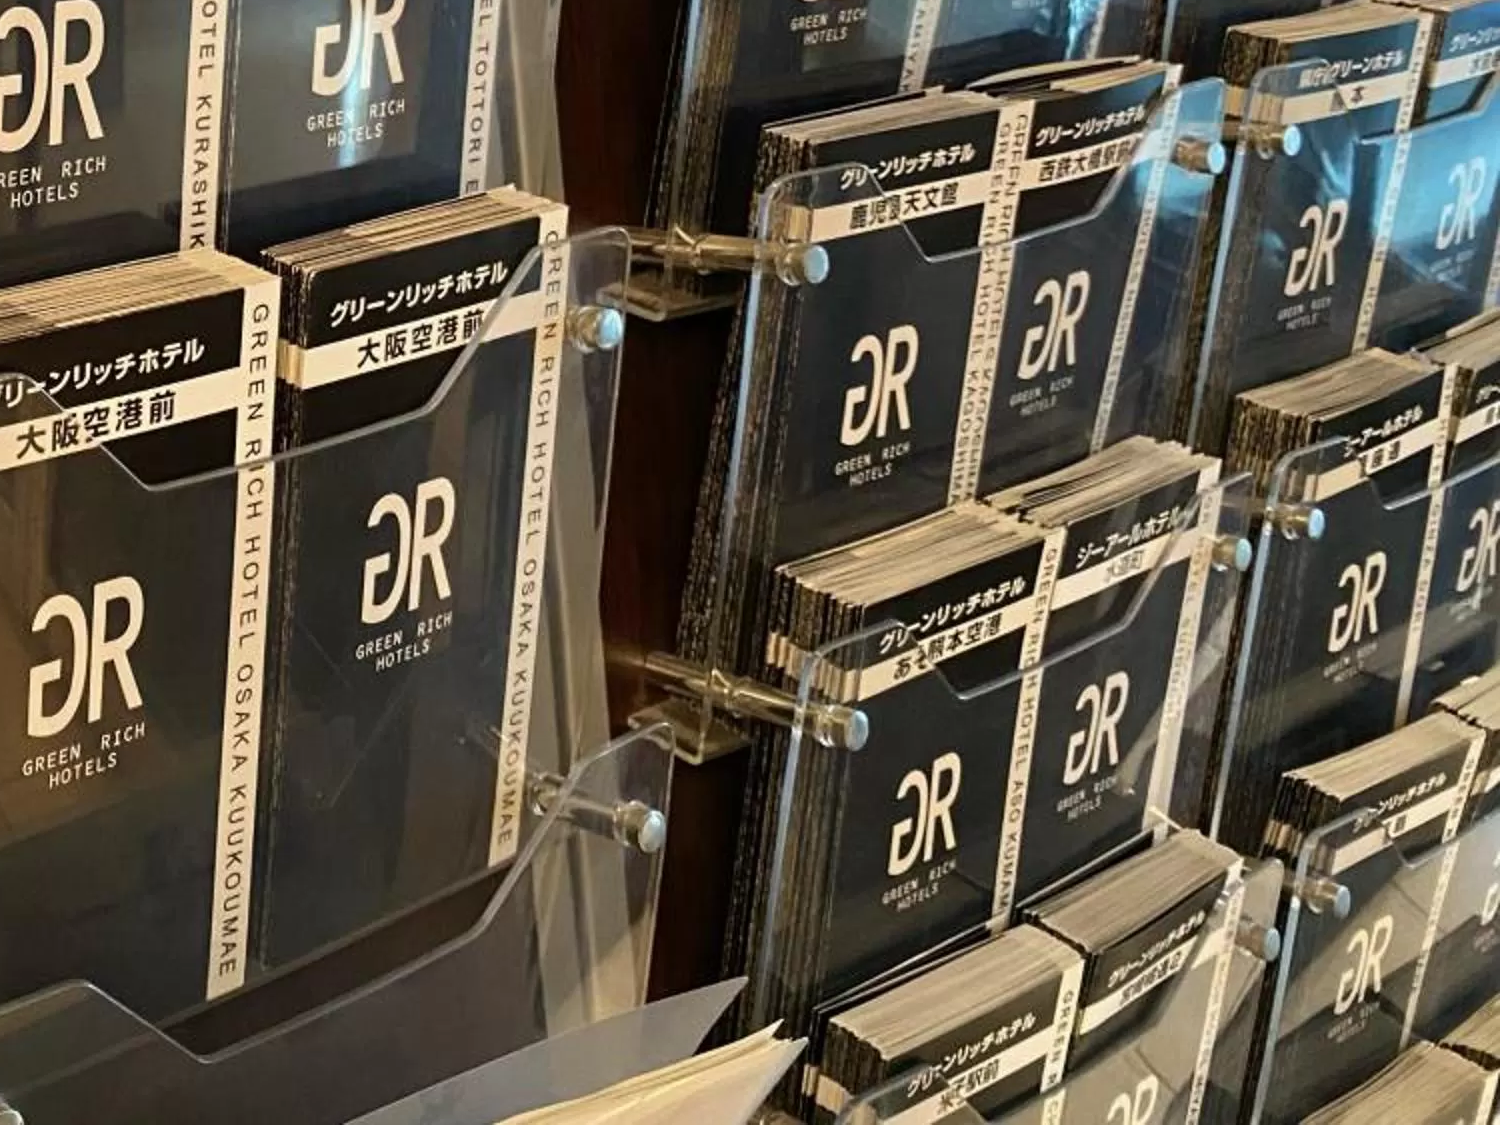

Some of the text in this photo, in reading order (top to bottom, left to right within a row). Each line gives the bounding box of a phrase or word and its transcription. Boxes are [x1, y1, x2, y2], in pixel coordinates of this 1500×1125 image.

[307, 97, 405, 132] GREEN RICH
[468, 39, 490, 165] TOTTORI
[326, 122, 384, 147] HOTELS
[61, 156, 106, 178] RICH
[839, 143, 976, 190] グリーンリッチホテル
[10, 183, 79, 209] HOTELS
[330, 260, 508, 328] グリーンリッチホテル
[357, 307, 483, 369] 大阪空港前
[15, 388, 178, 460] 大阪空港前
[835, 442, 911, 476] GREEN RICH
[849, 465, 892, 487] HOTELS
[498, 228, 565, 846] GREEN RICH HOTEL OSAKA KUUKOUMAE
[355, 611, 453, 659] GREEN RICH
[880, 576, 1026, 655] グリーンリッチホテル
[218, 303, 270, 978] GREEN RICH HOTEL OSAKA KUUKOUMAE
[374, 637, 430, 671] HOTELS
[22, 722, 146, 777] GREEN RICH
[49, 752, 118, 790] HOTELS
[907, 1012, 1036, 1098] グリーンリッチホテル
